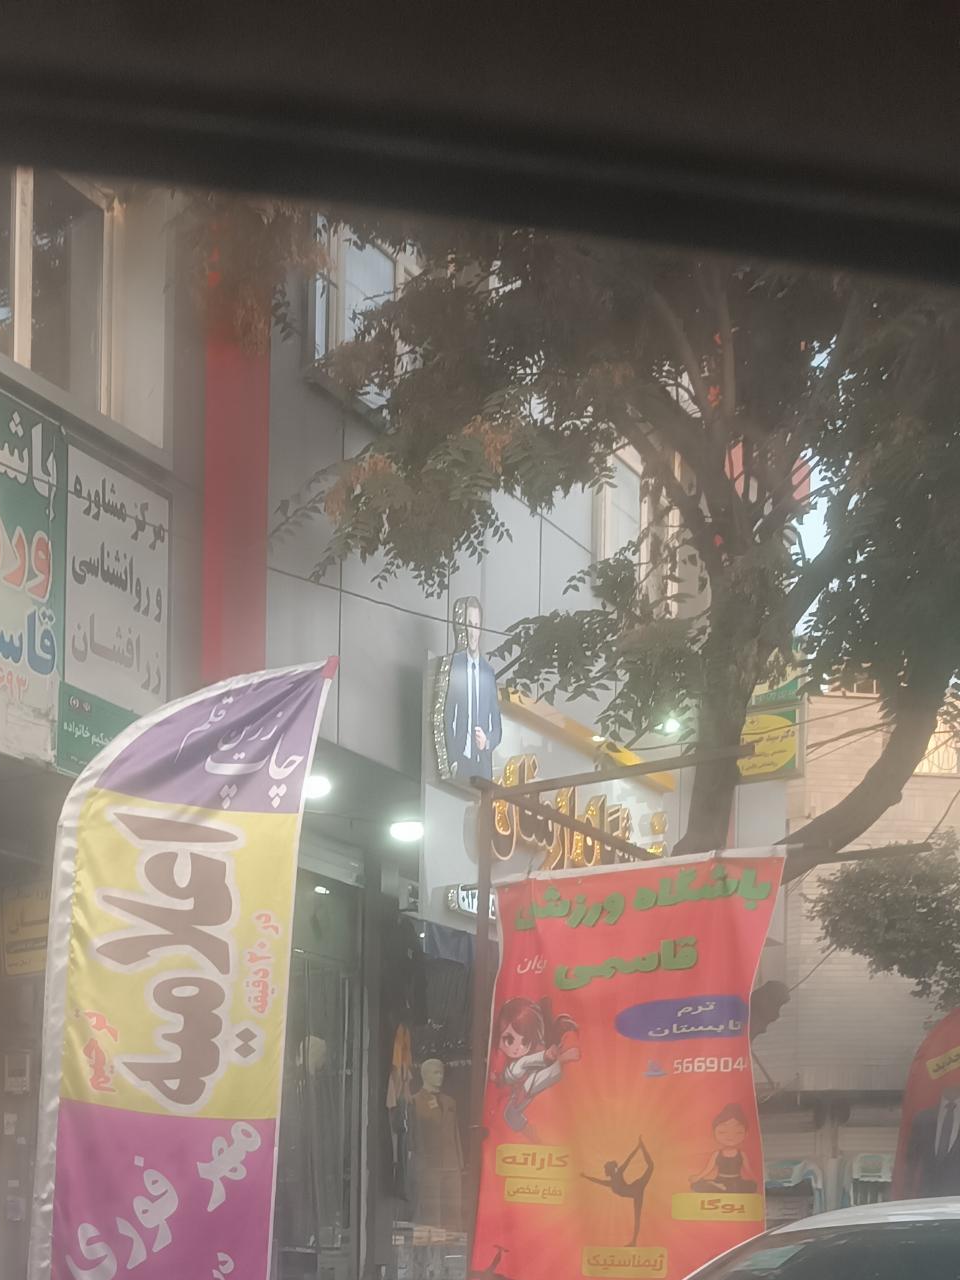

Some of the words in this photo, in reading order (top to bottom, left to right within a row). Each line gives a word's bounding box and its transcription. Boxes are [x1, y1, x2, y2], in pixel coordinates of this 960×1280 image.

[73, 474, 128, 523] مشاوره
[130, 501, 166, 551] مرکز
[71, 541, 151, 617] روانشناسی
[71, 613, 162, 695] زرافشان
[63, 721, 90, 738] خانواده
[174, 694, 234, 763] قلم
[217, 709, 287, 755] زرین
[203, 733, 305, 810] چاپ
[633, 864, 771, 910] باشگاه
[254, 911, 280, 936] در
[95, 811, 258, 1106] اعلامیه
[246, 966, 276, 1014] دقیقه
[676, 1000, 716, 1018] ترم
[647, 1017, 742, 1037] تابستان
[196, 1120, 262, 1213] مهر
[501, 1151, 569, 1171] کاراته
[700, 1199, 745, 1214] یوگا
[586, 1252, 666, 1272] ژیمناستیک
